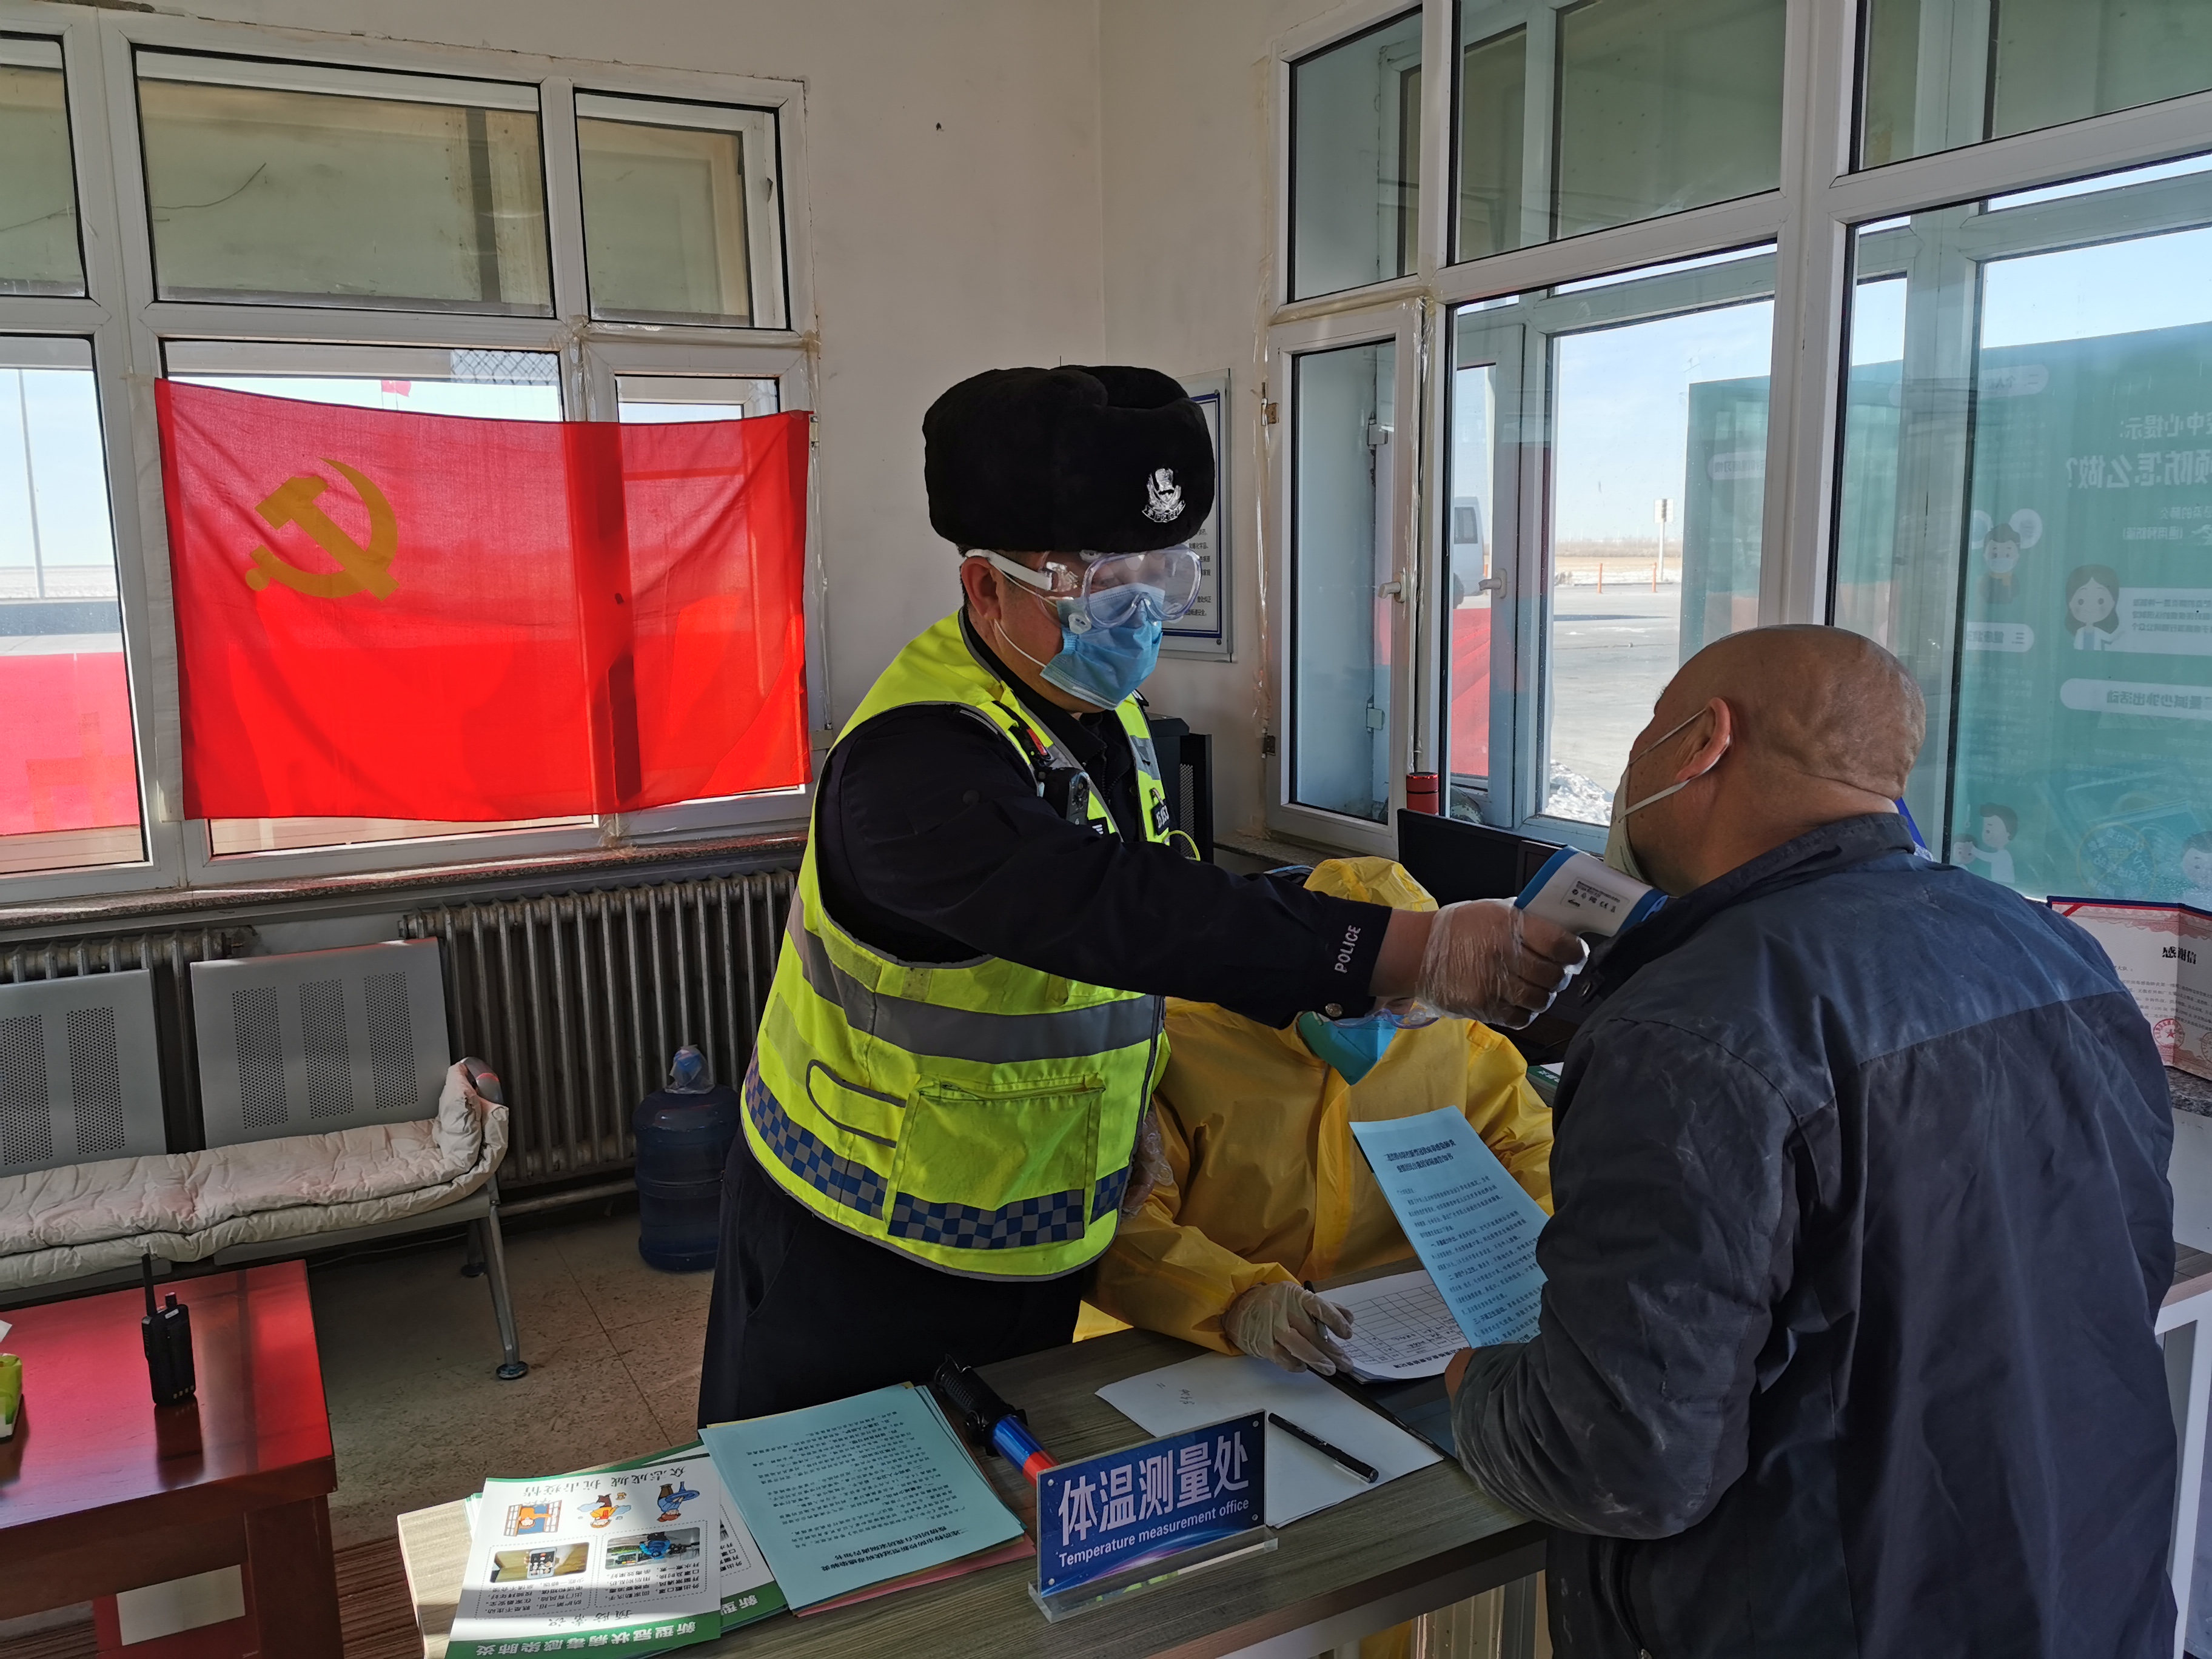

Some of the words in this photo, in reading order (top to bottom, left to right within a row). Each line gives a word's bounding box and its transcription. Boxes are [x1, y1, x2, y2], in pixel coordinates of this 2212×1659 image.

[1334, 925, 1361, 974] POLICE
[2162, 946, 2197, 965] 感谢信
[611, 1466, 686, 1487] 众志成城
[523, 1479, 601, 1499] 抗击疫情
[1058, 1430, 1248, 1546] 体温测量处
[1059, 1533, 1135, 1568] Temperature
[1138, 1508, 1216, 1543] measurement
[1219, 1496, 1249, 1519] office
[720, 1594, 759, 1615] 新型
[548, 1609, 633, 1629] 预防常识
[475, 1621, 697, 1658] 新型冠状病毒感染肺炎
